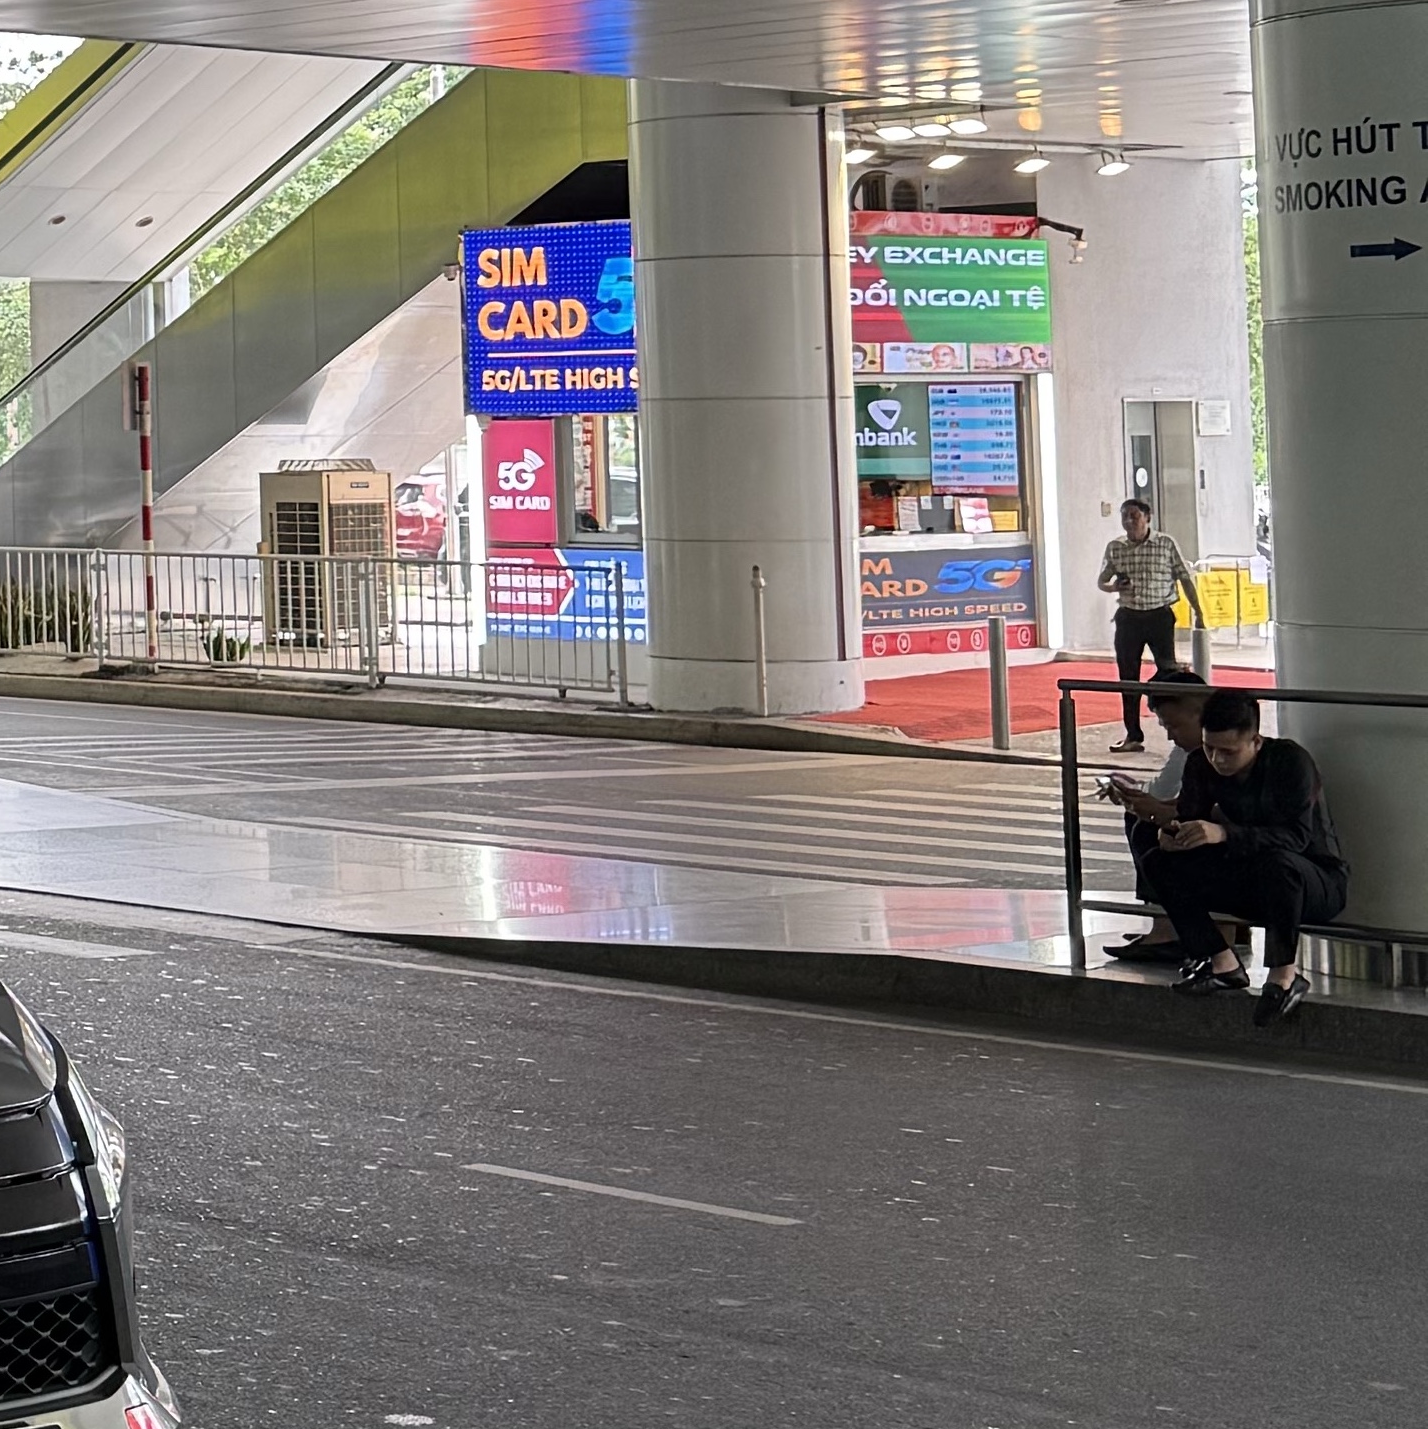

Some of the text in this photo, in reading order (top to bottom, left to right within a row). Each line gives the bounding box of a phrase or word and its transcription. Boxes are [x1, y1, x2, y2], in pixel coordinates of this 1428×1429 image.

[1333, 117, 1401, 157] HÚT
[1275, 175, 1407, 214] SMOKING
[477, 246, 547, 289] SIM
[883, 246, 1045, 266] EXCHANGE
[903, 288, 1001, 310] NGOẠI
[1005, 285, 1046, 310] TỆ
[477, 298, 588, 341] CARD
[482, 366, 560, 392] 5G/LTE
[565, 367, 624, 390] HIGH
[498, 461, 536, 491] 5G
[489, 495, 551, 510] SIM CARD
[934, 558, 1025, 594] 5G
[909, 606, 958, 618] HIGH
[964, 602, 1028, 615] SPEED
